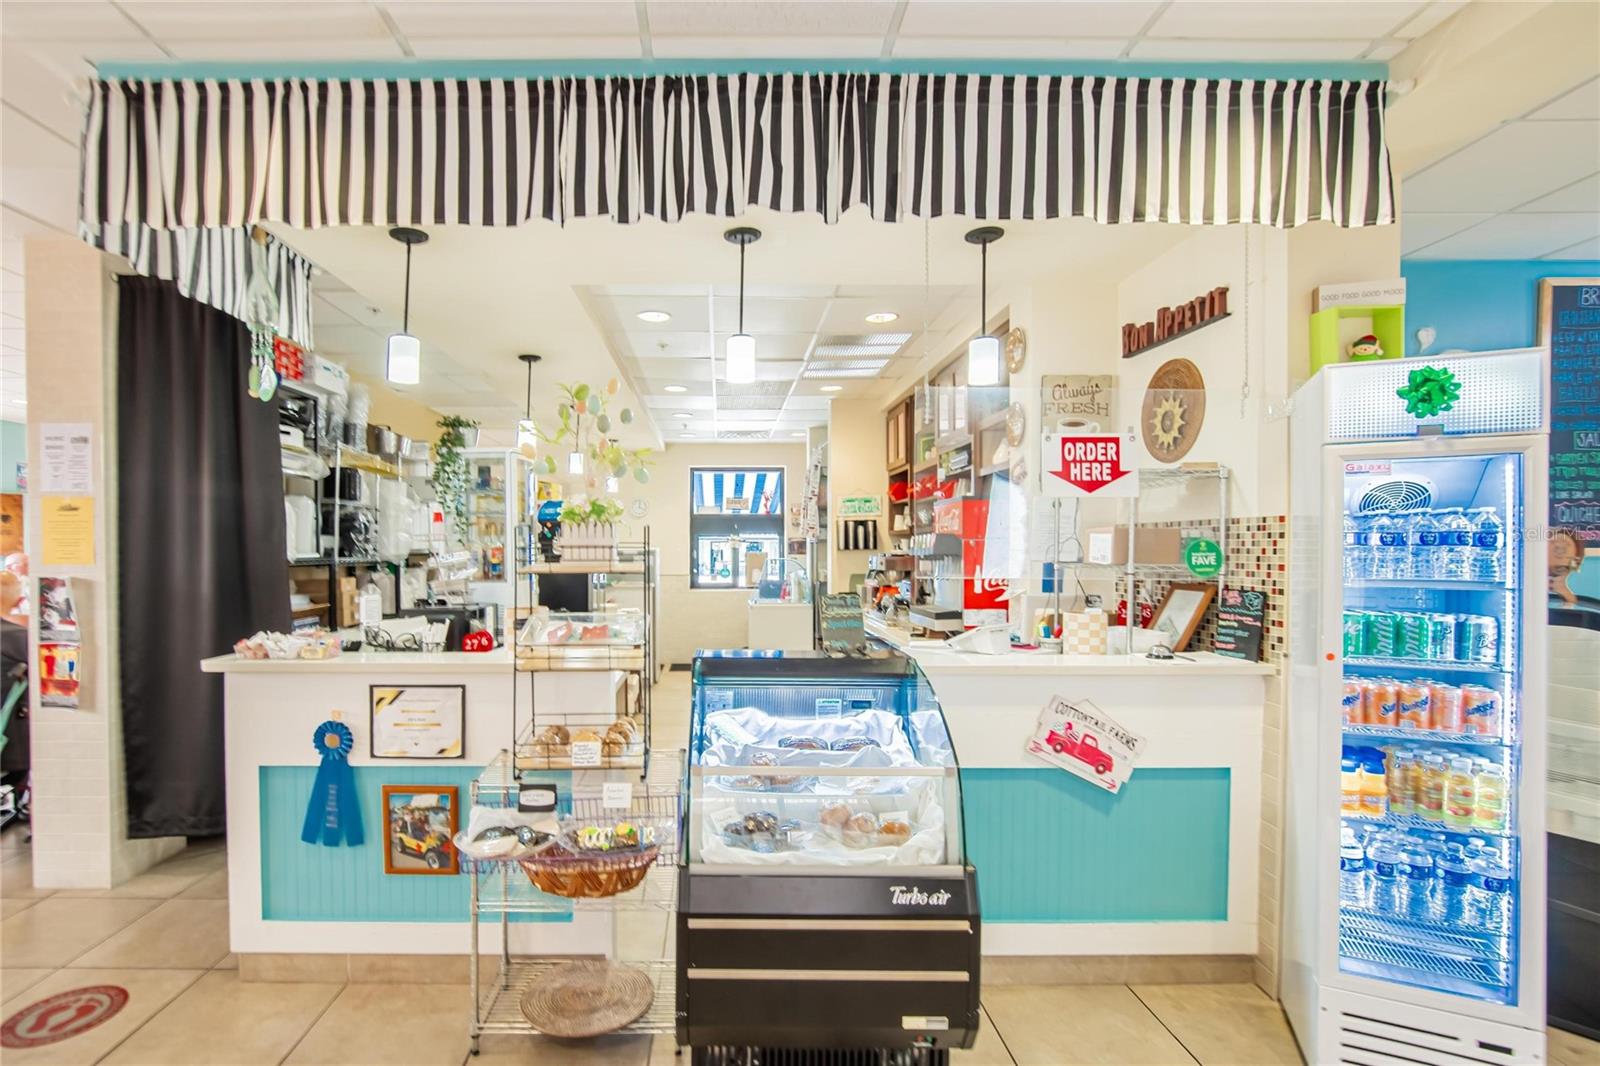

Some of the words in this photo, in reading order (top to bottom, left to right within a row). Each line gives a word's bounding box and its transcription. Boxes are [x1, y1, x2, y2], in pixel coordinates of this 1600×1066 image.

[1121, 322, 1154, 355] BON
[1154, 287, 1229, 342] APPETIT
[1051, 383, 1102, 403] Always
[1043, 402, 1109, 416] FRESH
[1064, 442, 1118, 461] ORDER
[1070, 462, 1112, 481] HERE
[1345, 463, 1392, 471] Galaxy
[1191, 556, 1217, 565] FAVE
[889, 885, 928, 906] Turbo
[929, 889, 952, 906] air
